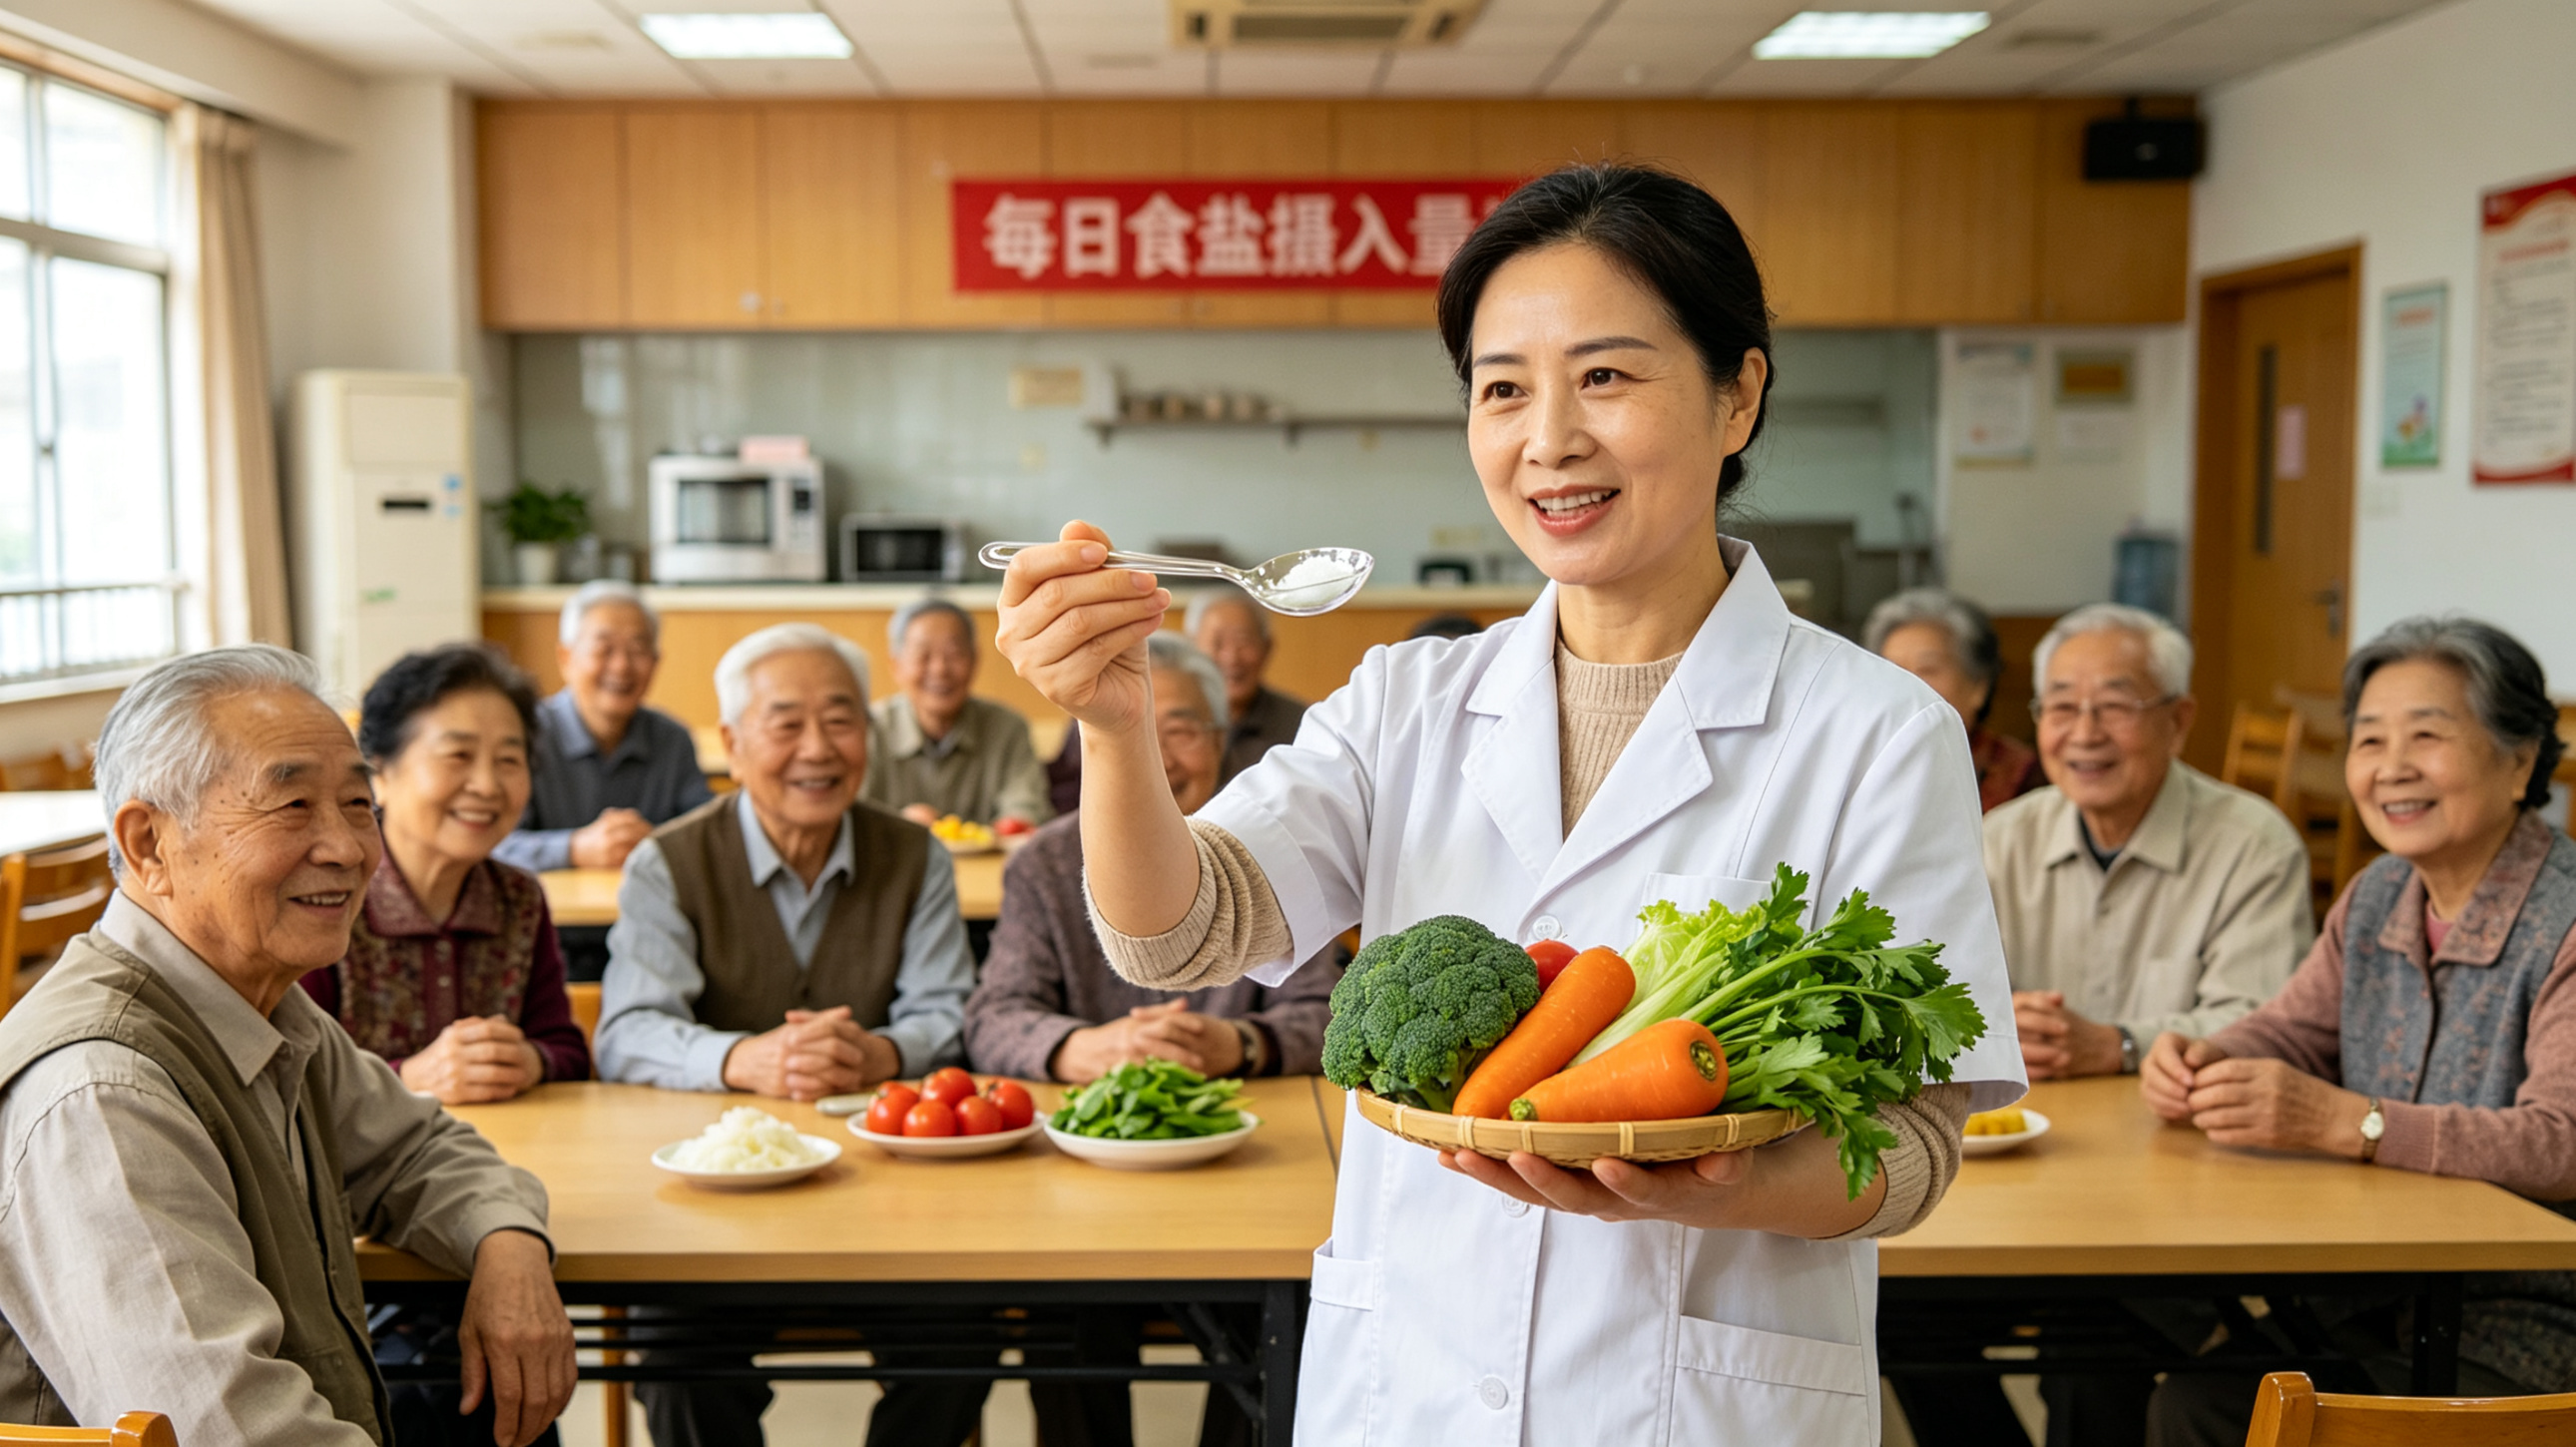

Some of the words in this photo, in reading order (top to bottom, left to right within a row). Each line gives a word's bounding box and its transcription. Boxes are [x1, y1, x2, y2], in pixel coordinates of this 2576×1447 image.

[982, 191, 1502, 277] 每日食盐摄入量
